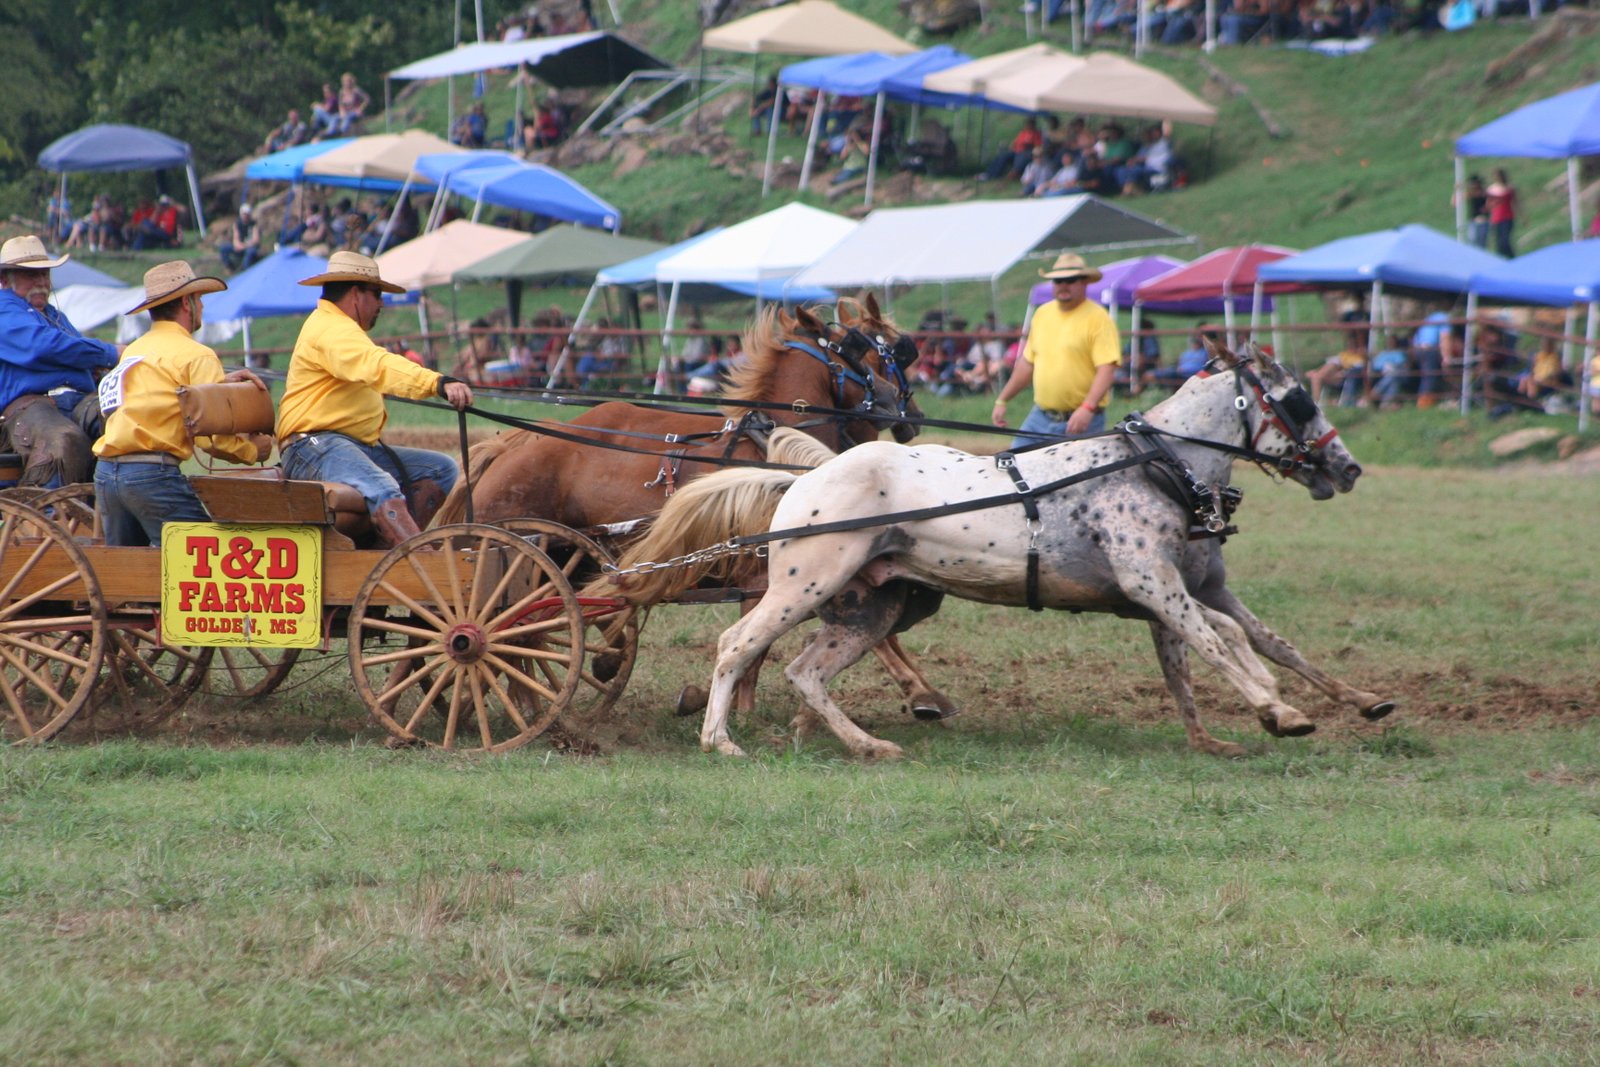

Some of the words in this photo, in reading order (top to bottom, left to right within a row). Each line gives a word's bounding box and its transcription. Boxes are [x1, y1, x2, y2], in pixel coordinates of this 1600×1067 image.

[186, 536, 299, 579] T&D
[178, 581, 306, 614] FARMS
[269, 618, 297, 635] MS
